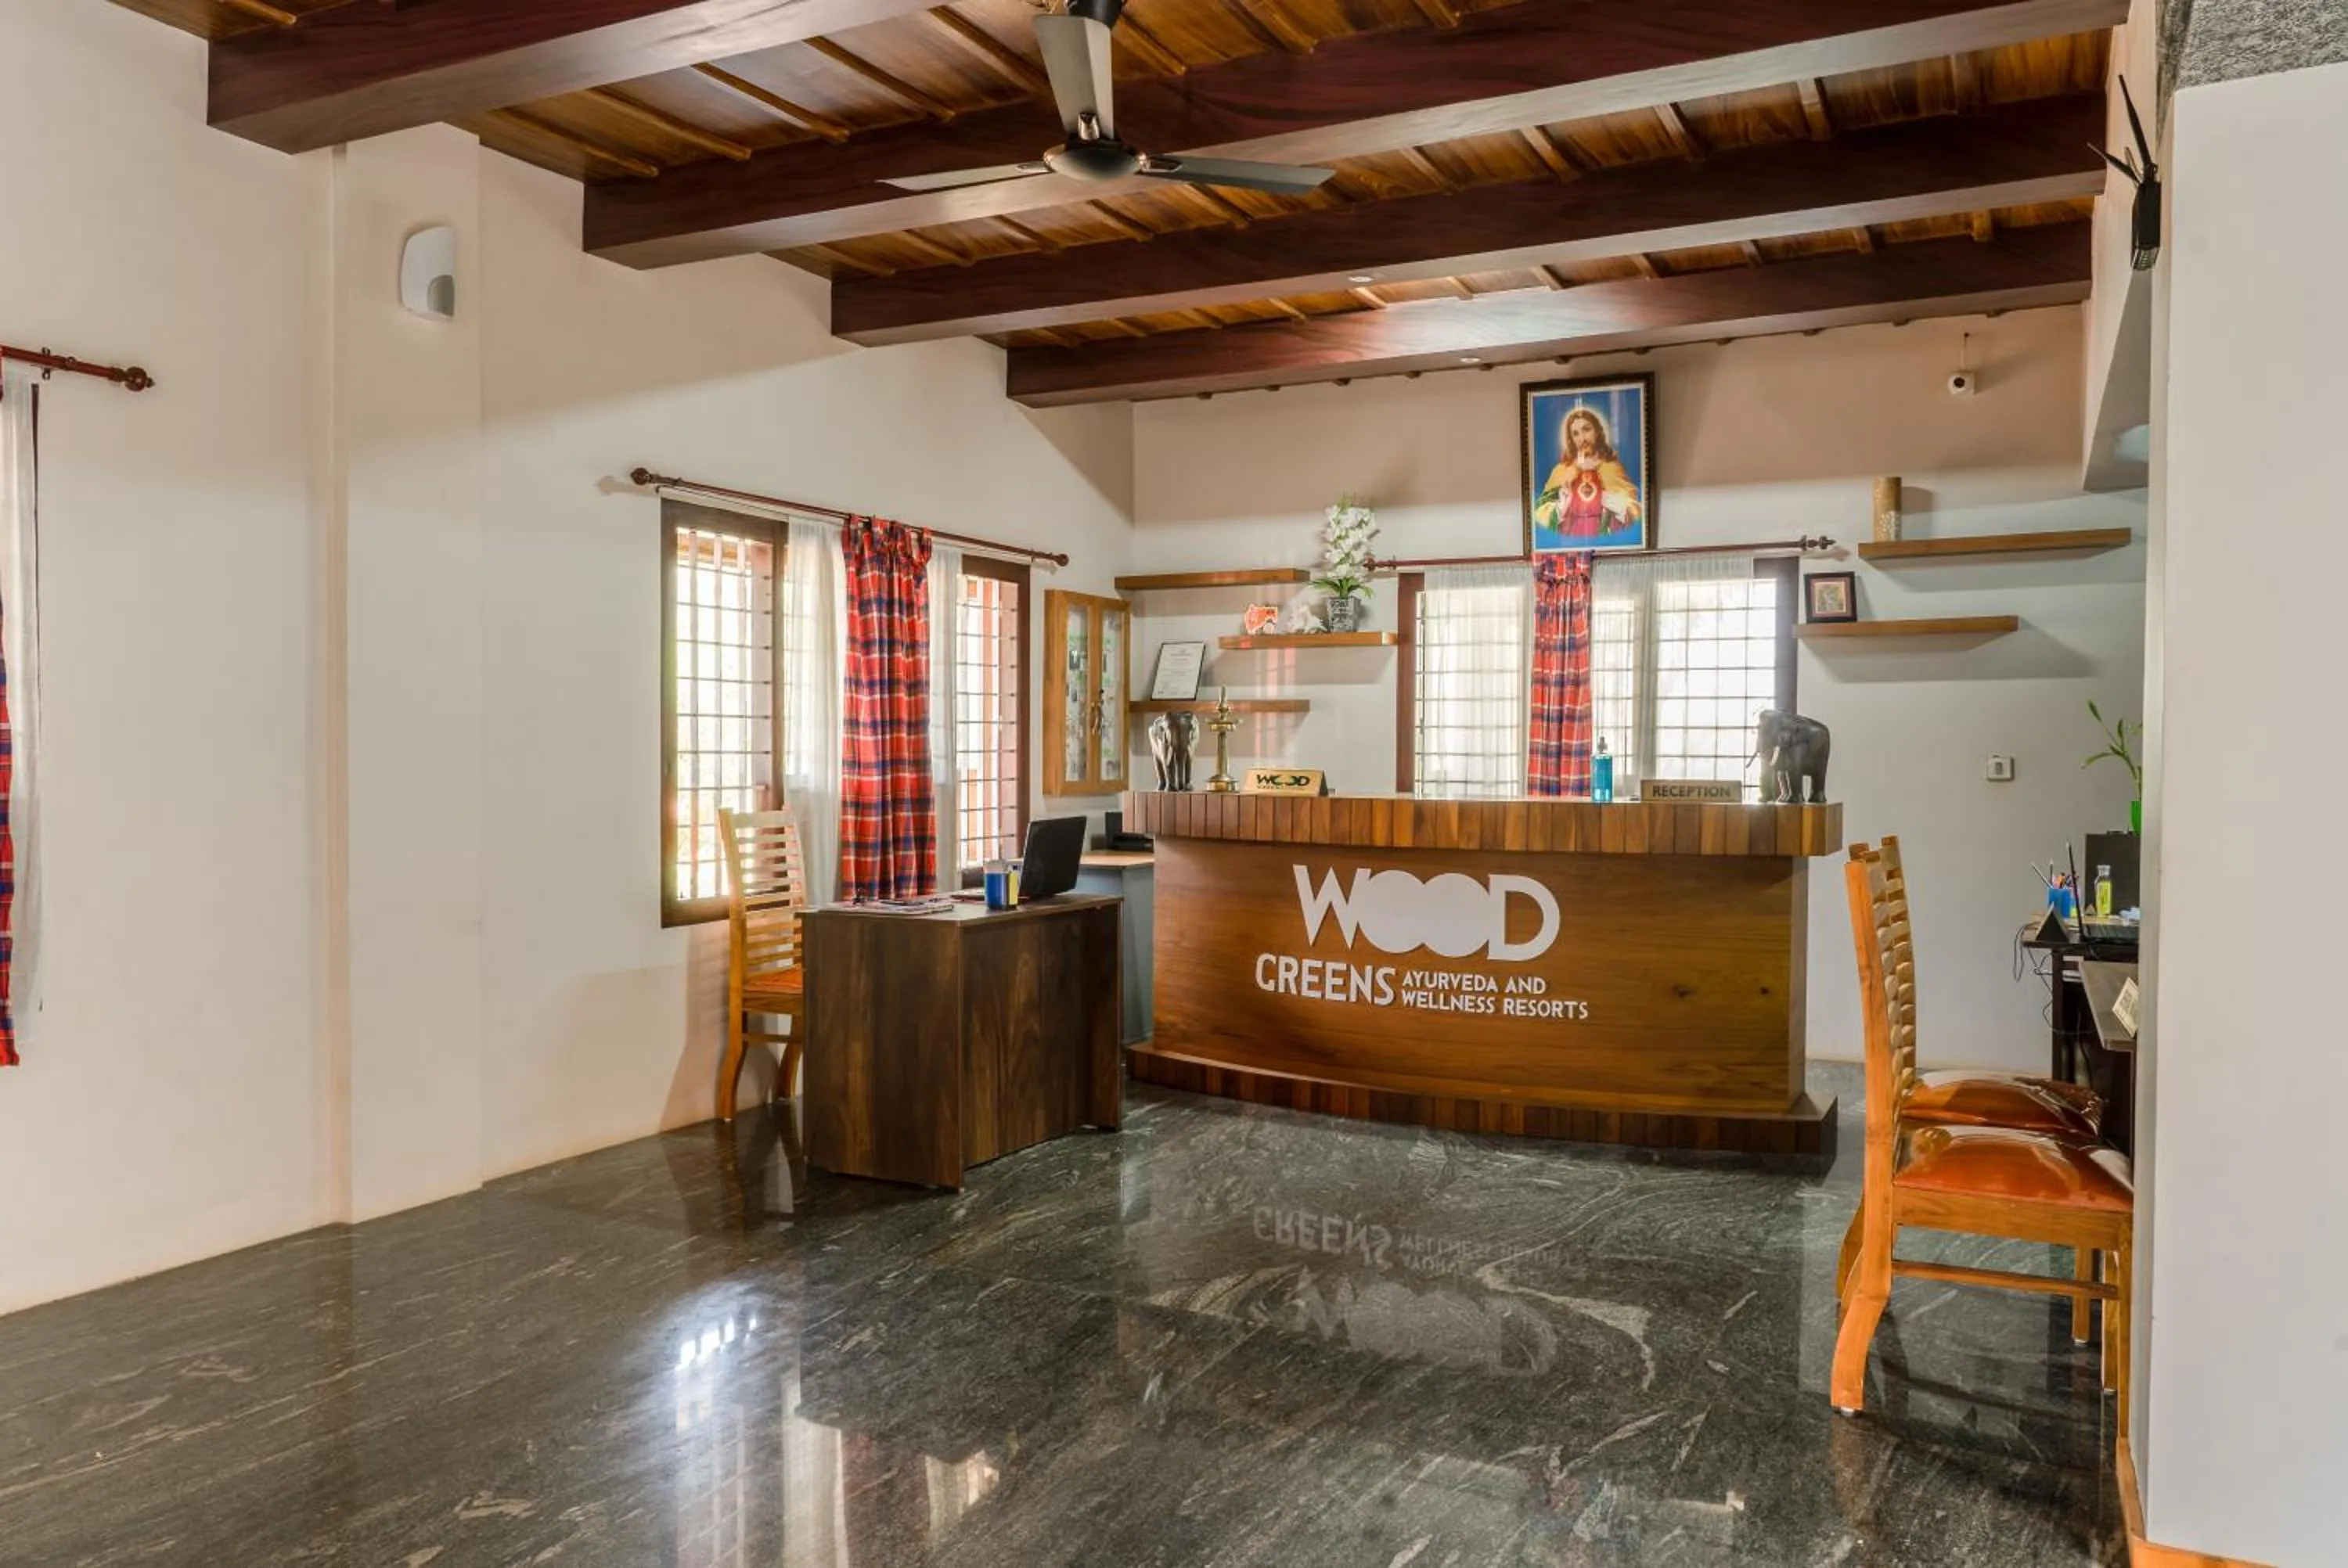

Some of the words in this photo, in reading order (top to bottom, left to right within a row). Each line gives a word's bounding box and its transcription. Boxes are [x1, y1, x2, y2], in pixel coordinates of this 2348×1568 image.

[1653, 785, 1731, 797] RECEPTION
[1293, 864, 1561, 962] WOOD
[1255, 953, 1398, 1006] GREENS
[1402, 970, 1499, 993] AYURVEDA
[1505, 976, 1547, 994] AND
[1401, 990, 1496, 1014] WELLNESS
[1503, 998, 1589, 1020] RESORTS
